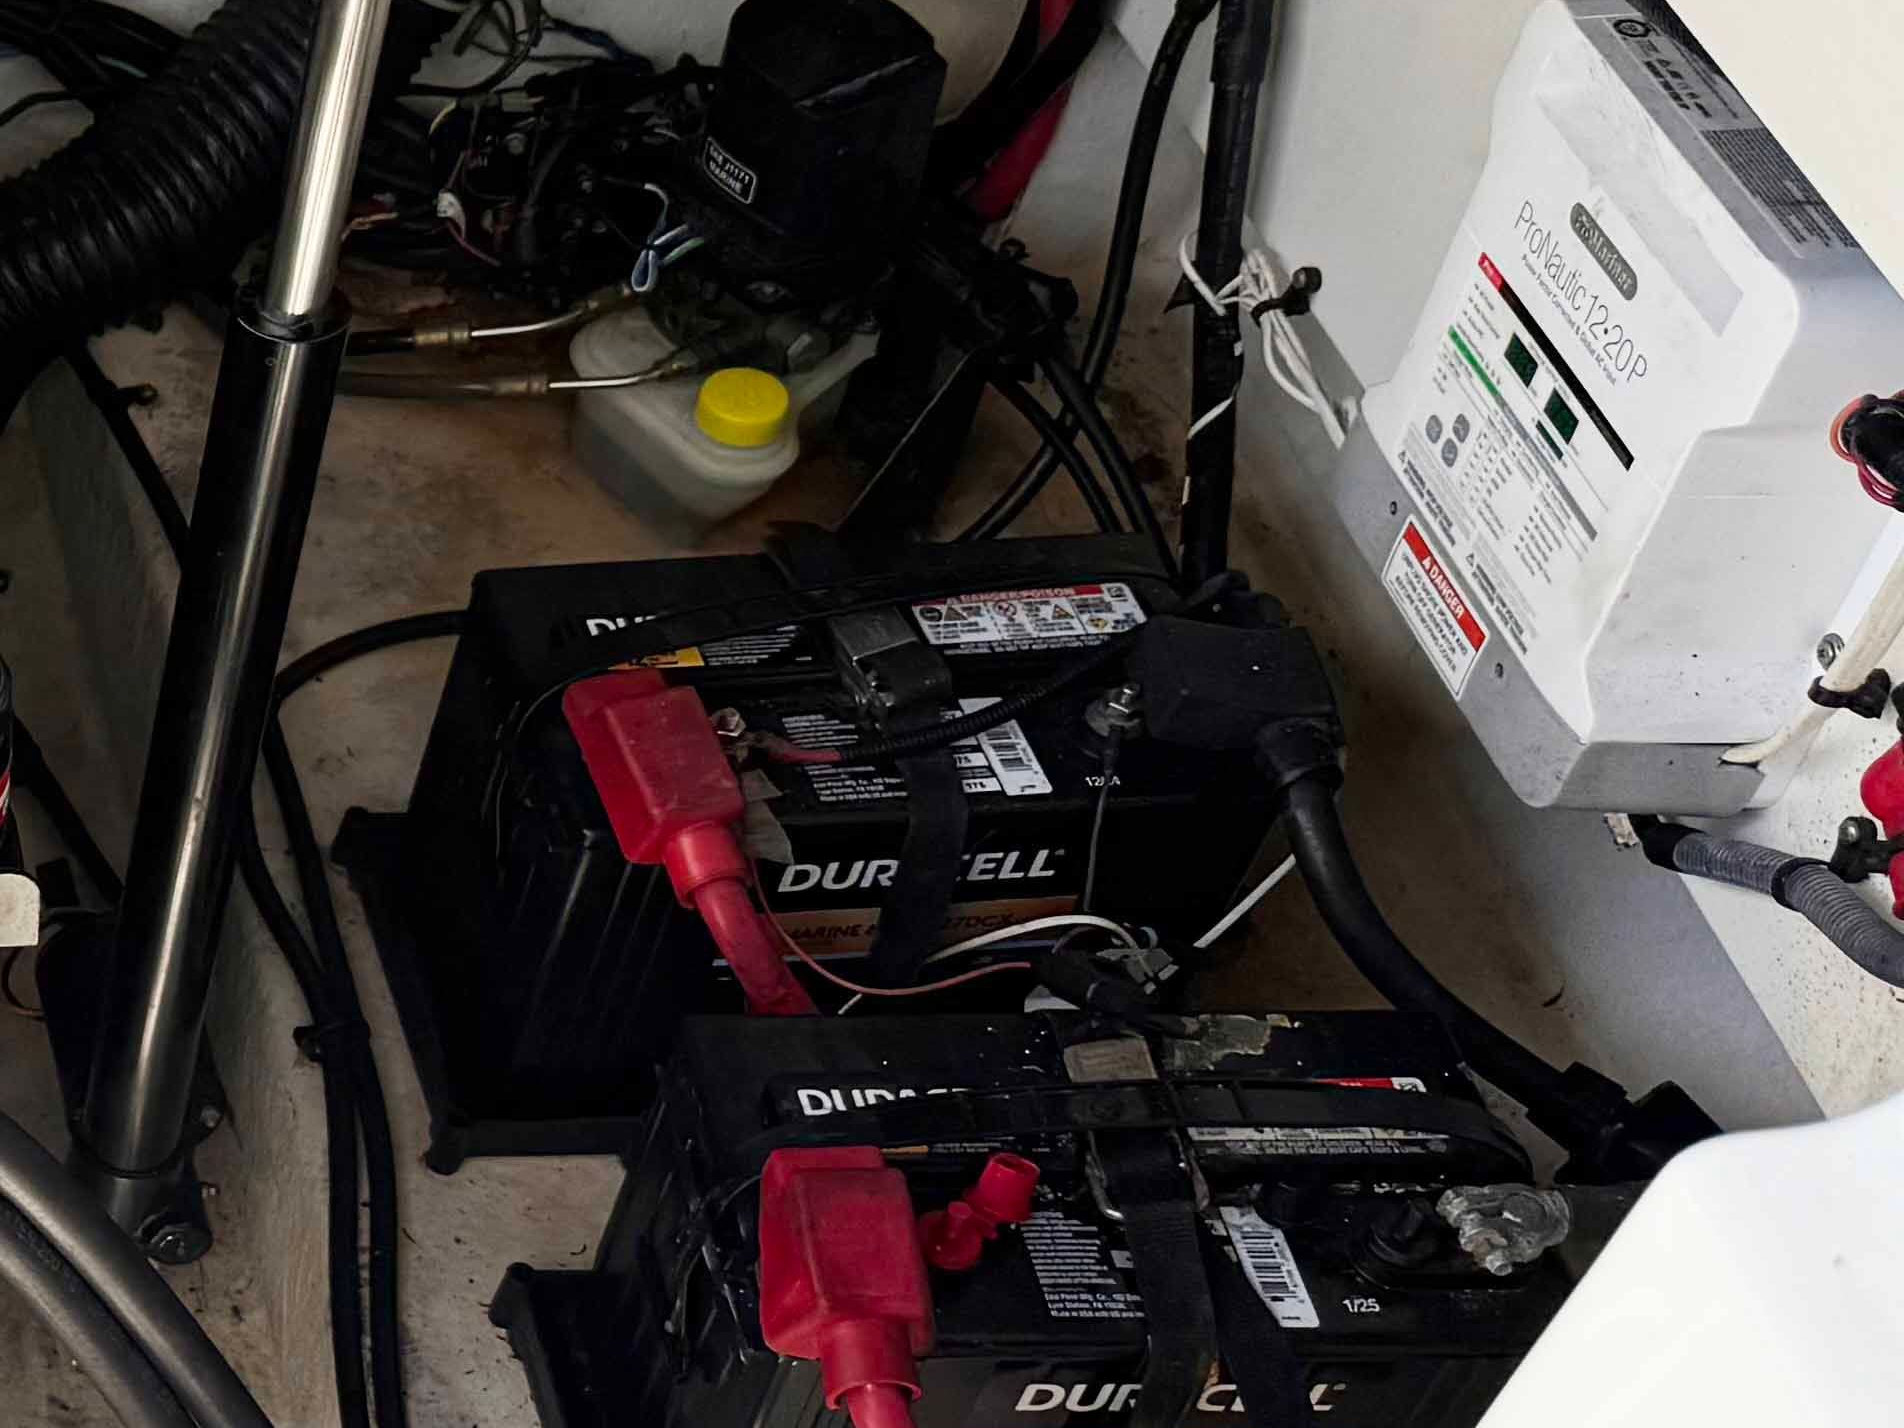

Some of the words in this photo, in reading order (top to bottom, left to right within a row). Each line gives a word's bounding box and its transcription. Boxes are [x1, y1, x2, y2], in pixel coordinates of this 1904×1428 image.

[1515, 200, 1588, 311] ProNautic
[1429, 561, 1465, 622] DANGER
[777, 849, 1056, 892] DURELL
[1342, 1297, 1380, 1312] 1/25
